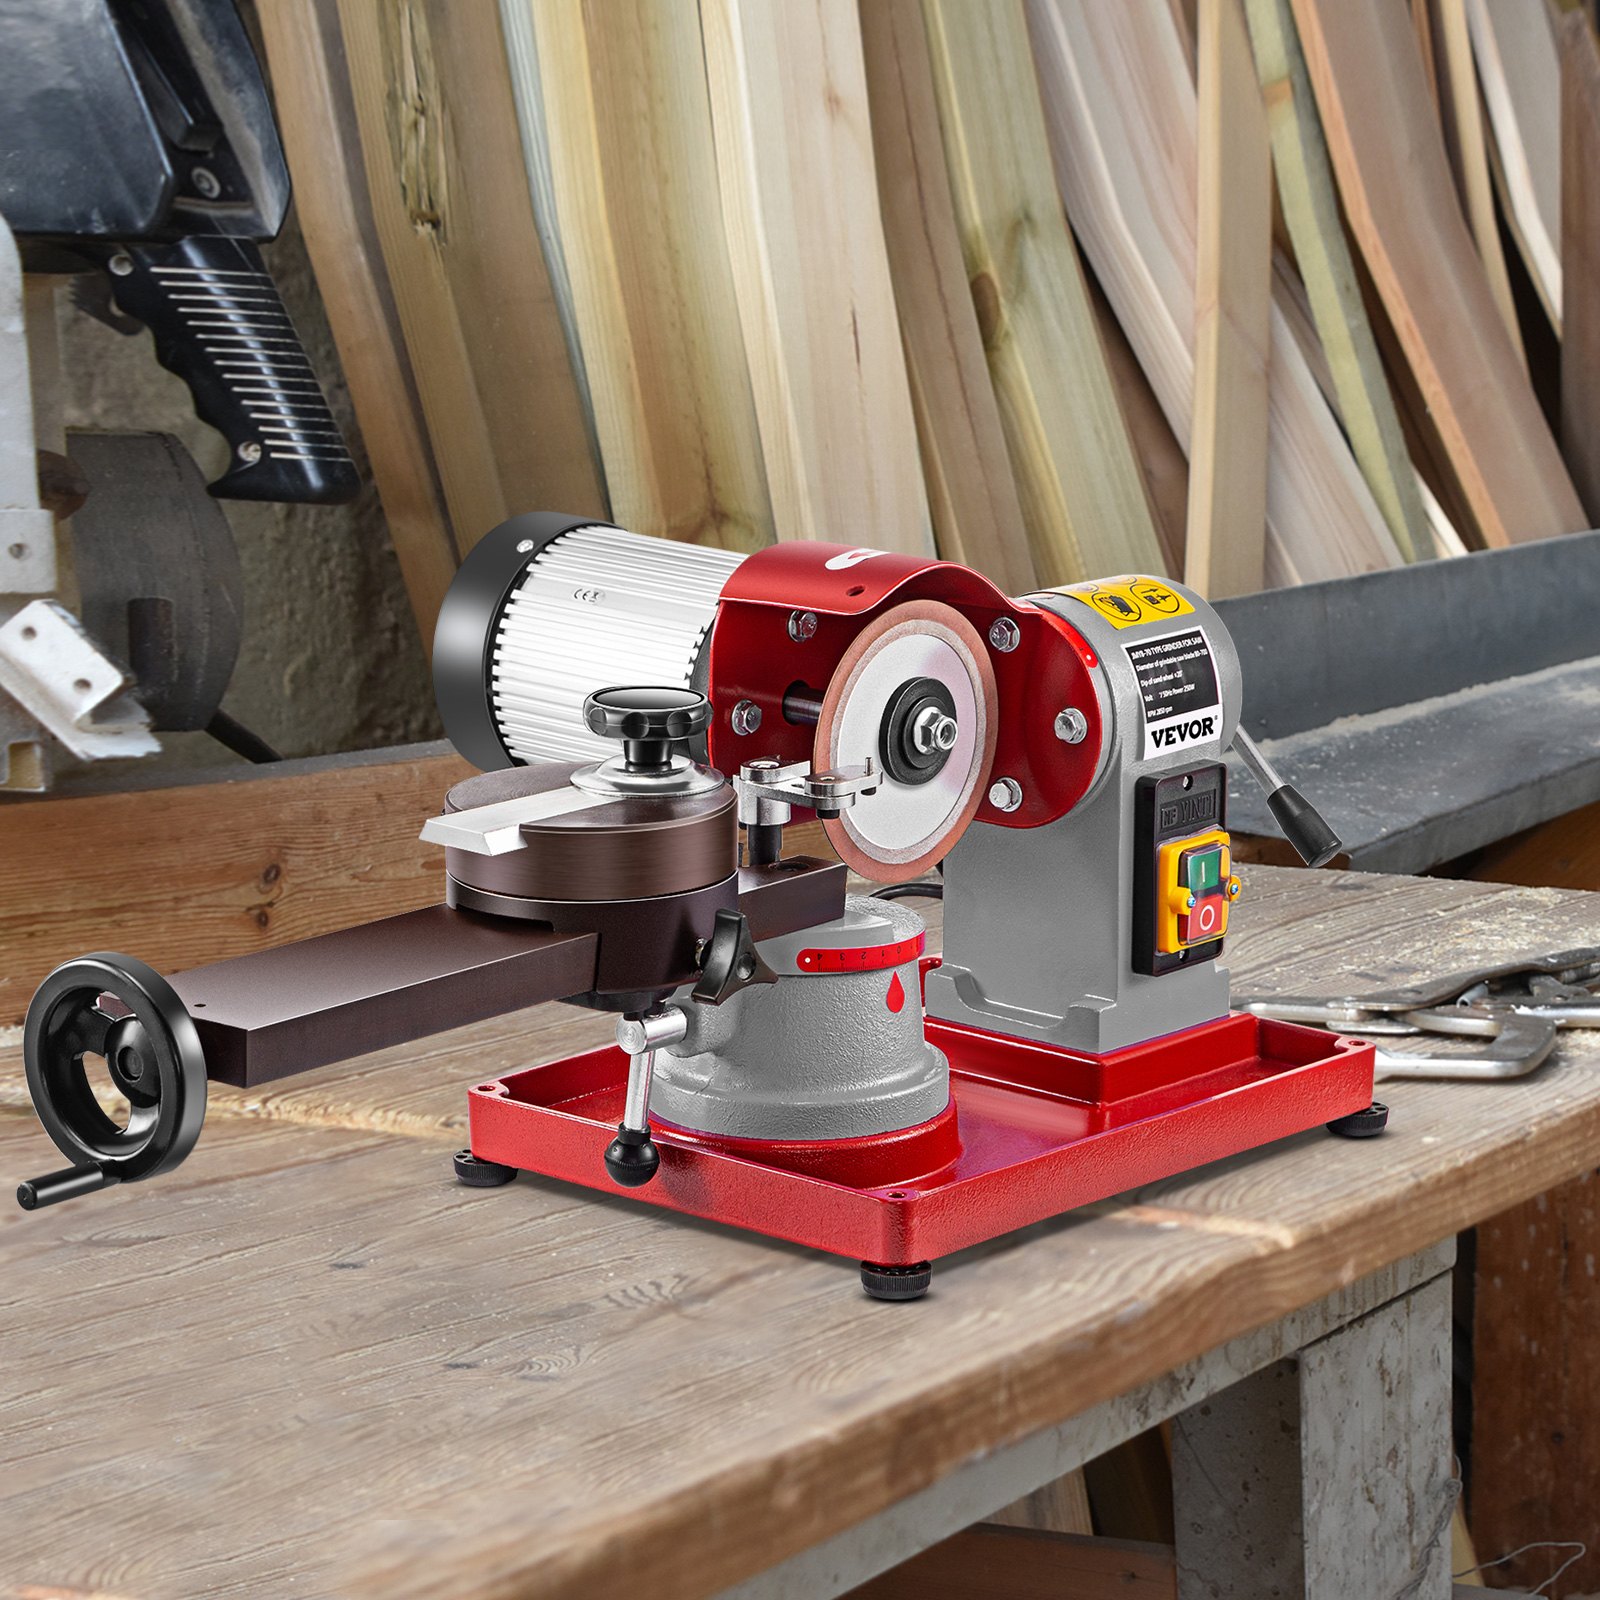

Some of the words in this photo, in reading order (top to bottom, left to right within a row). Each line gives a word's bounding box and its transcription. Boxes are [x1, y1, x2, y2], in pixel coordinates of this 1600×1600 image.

[1151, 645, 1163, 655] TYPE
[1162, 641, 1183, 652] GRINDER
[1183, 639, 1192, 647] FOR
[1191, 636, 1203, 645] SAW
[1151, 717, 1214, 748] VEVOR
